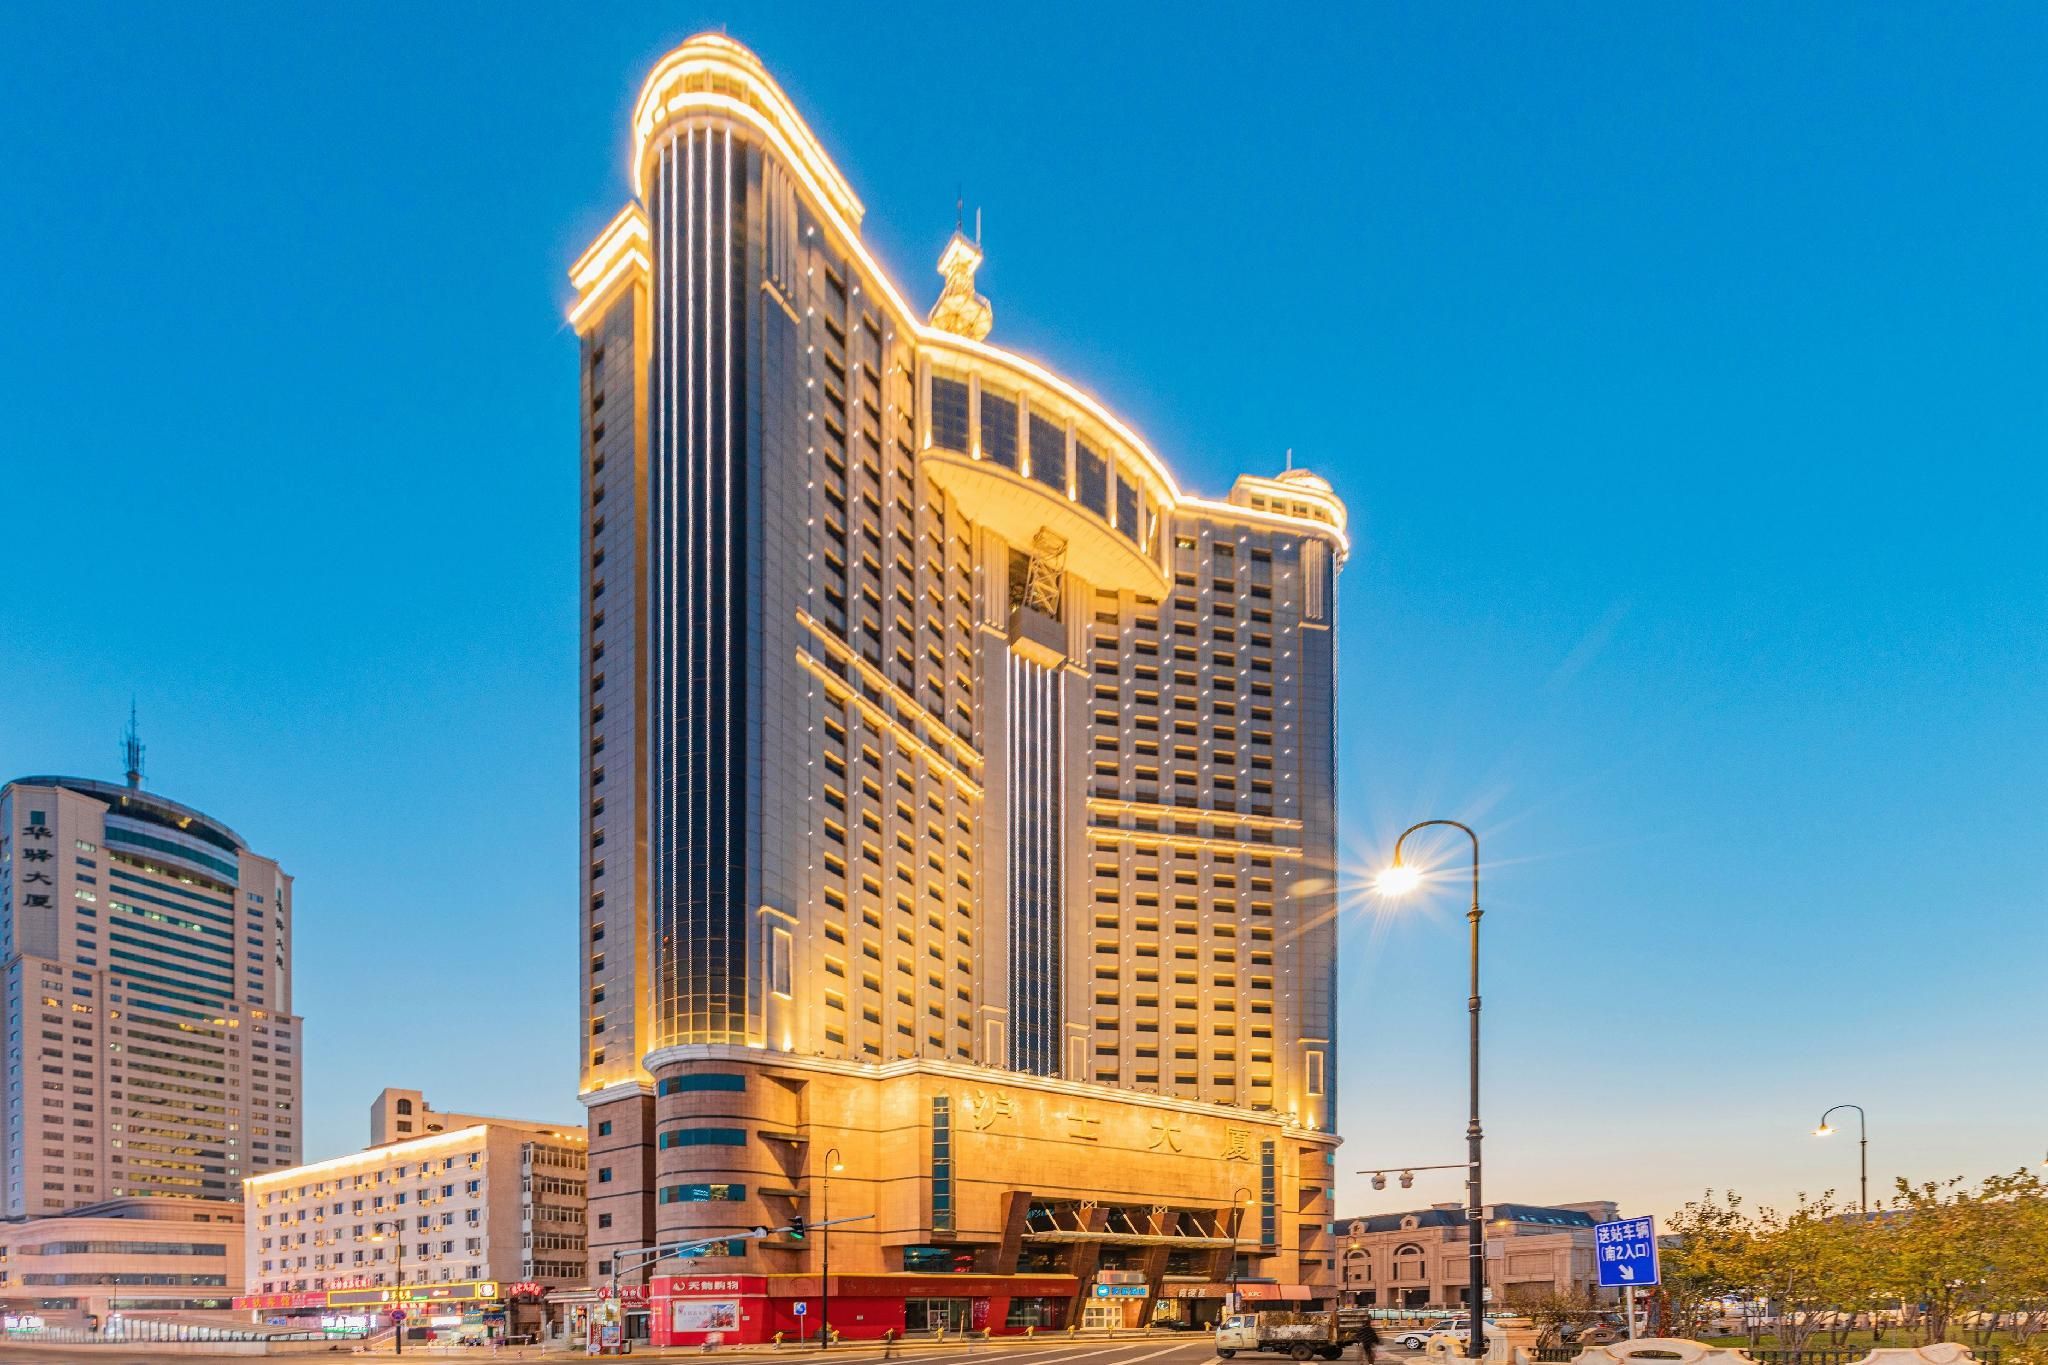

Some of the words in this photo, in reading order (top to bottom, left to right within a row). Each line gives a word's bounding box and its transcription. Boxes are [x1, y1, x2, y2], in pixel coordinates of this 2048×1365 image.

[22, 826, 53, 909] 华驿大厦
[1598, 1221, 1650, 1243] 送站车辆
[1601, 1242, 1650, 1261] (南2入口)
